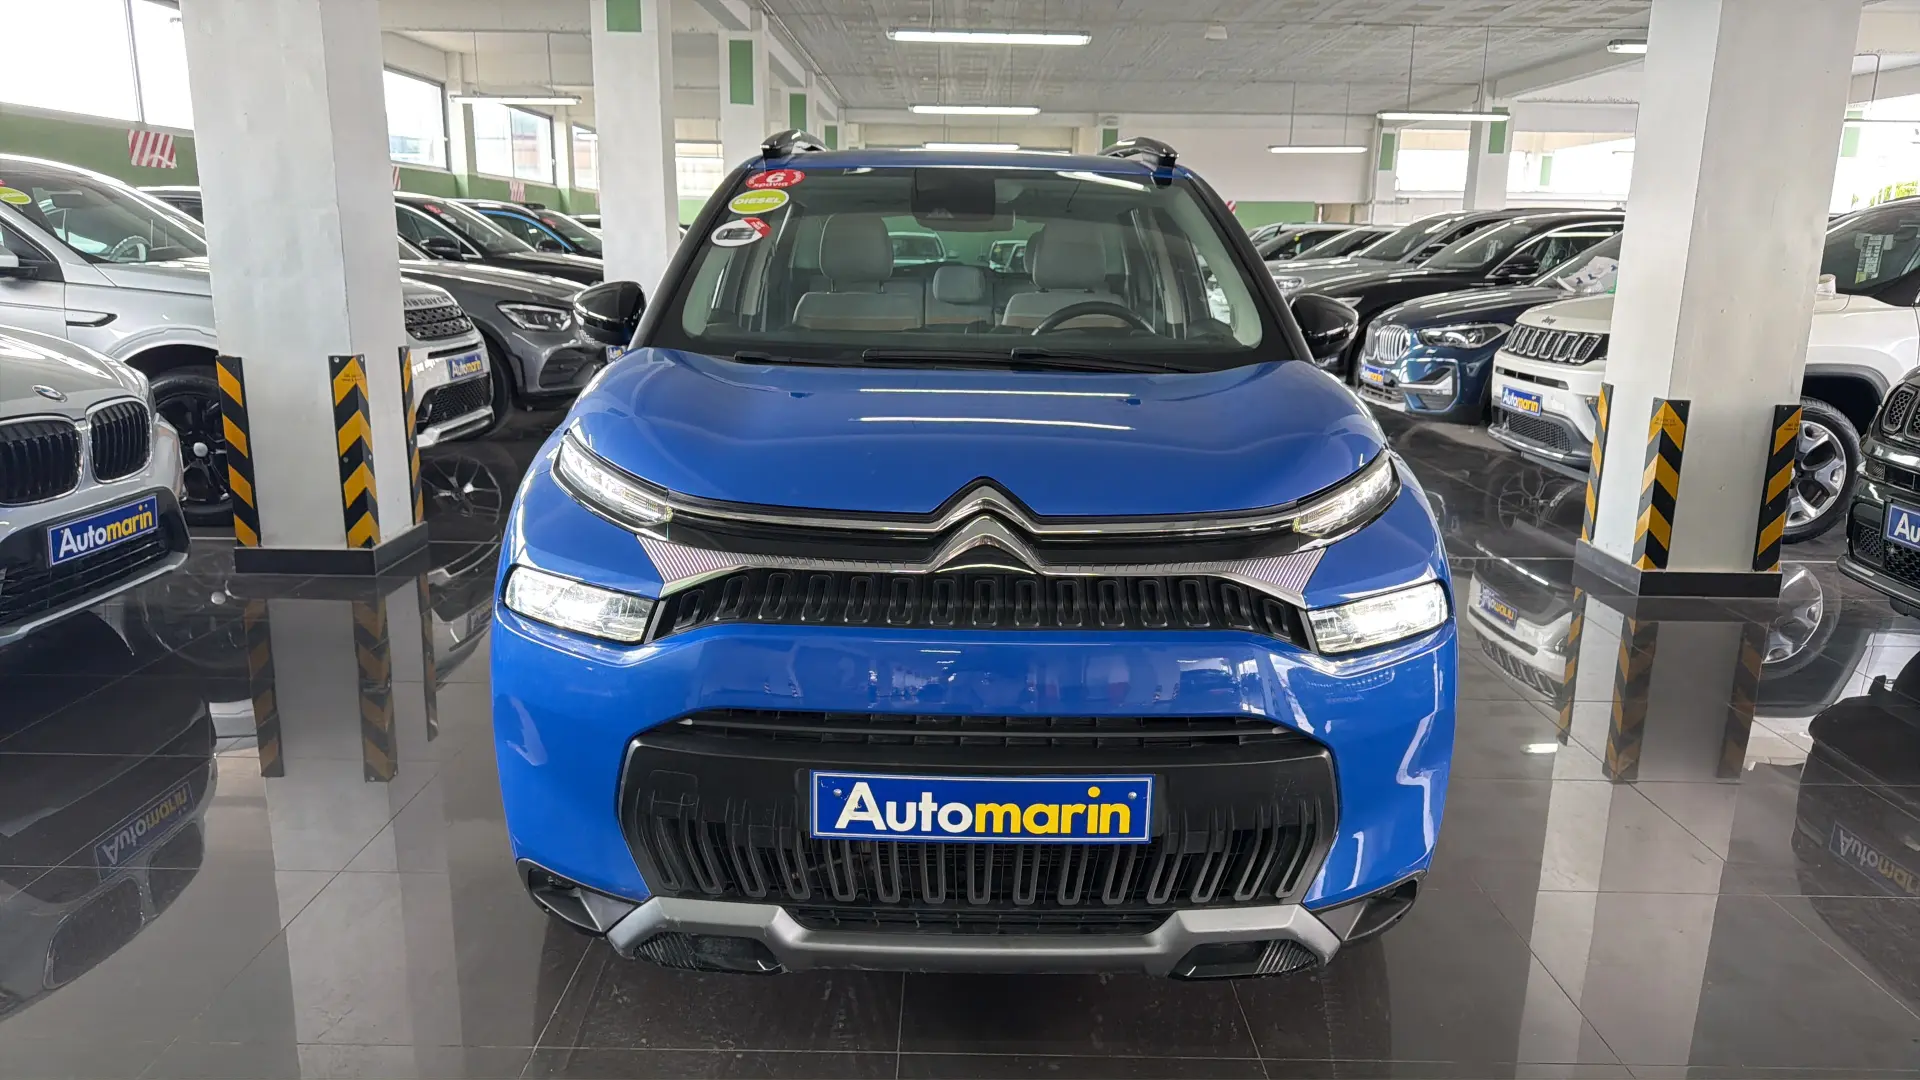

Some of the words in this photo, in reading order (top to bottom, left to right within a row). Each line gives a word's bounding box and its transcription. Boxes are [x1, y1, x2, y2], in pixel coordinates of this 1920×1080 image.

[766, 172, 786, 183] 6
[735, 197, 781, 205] DIESEL
[1503, 388, 1539, 413] Automarin
[58, 504, 153, 558] Automarin
[1894, 512, 1920, 543] Au
[834, 781, 1131, 836] Automarin
